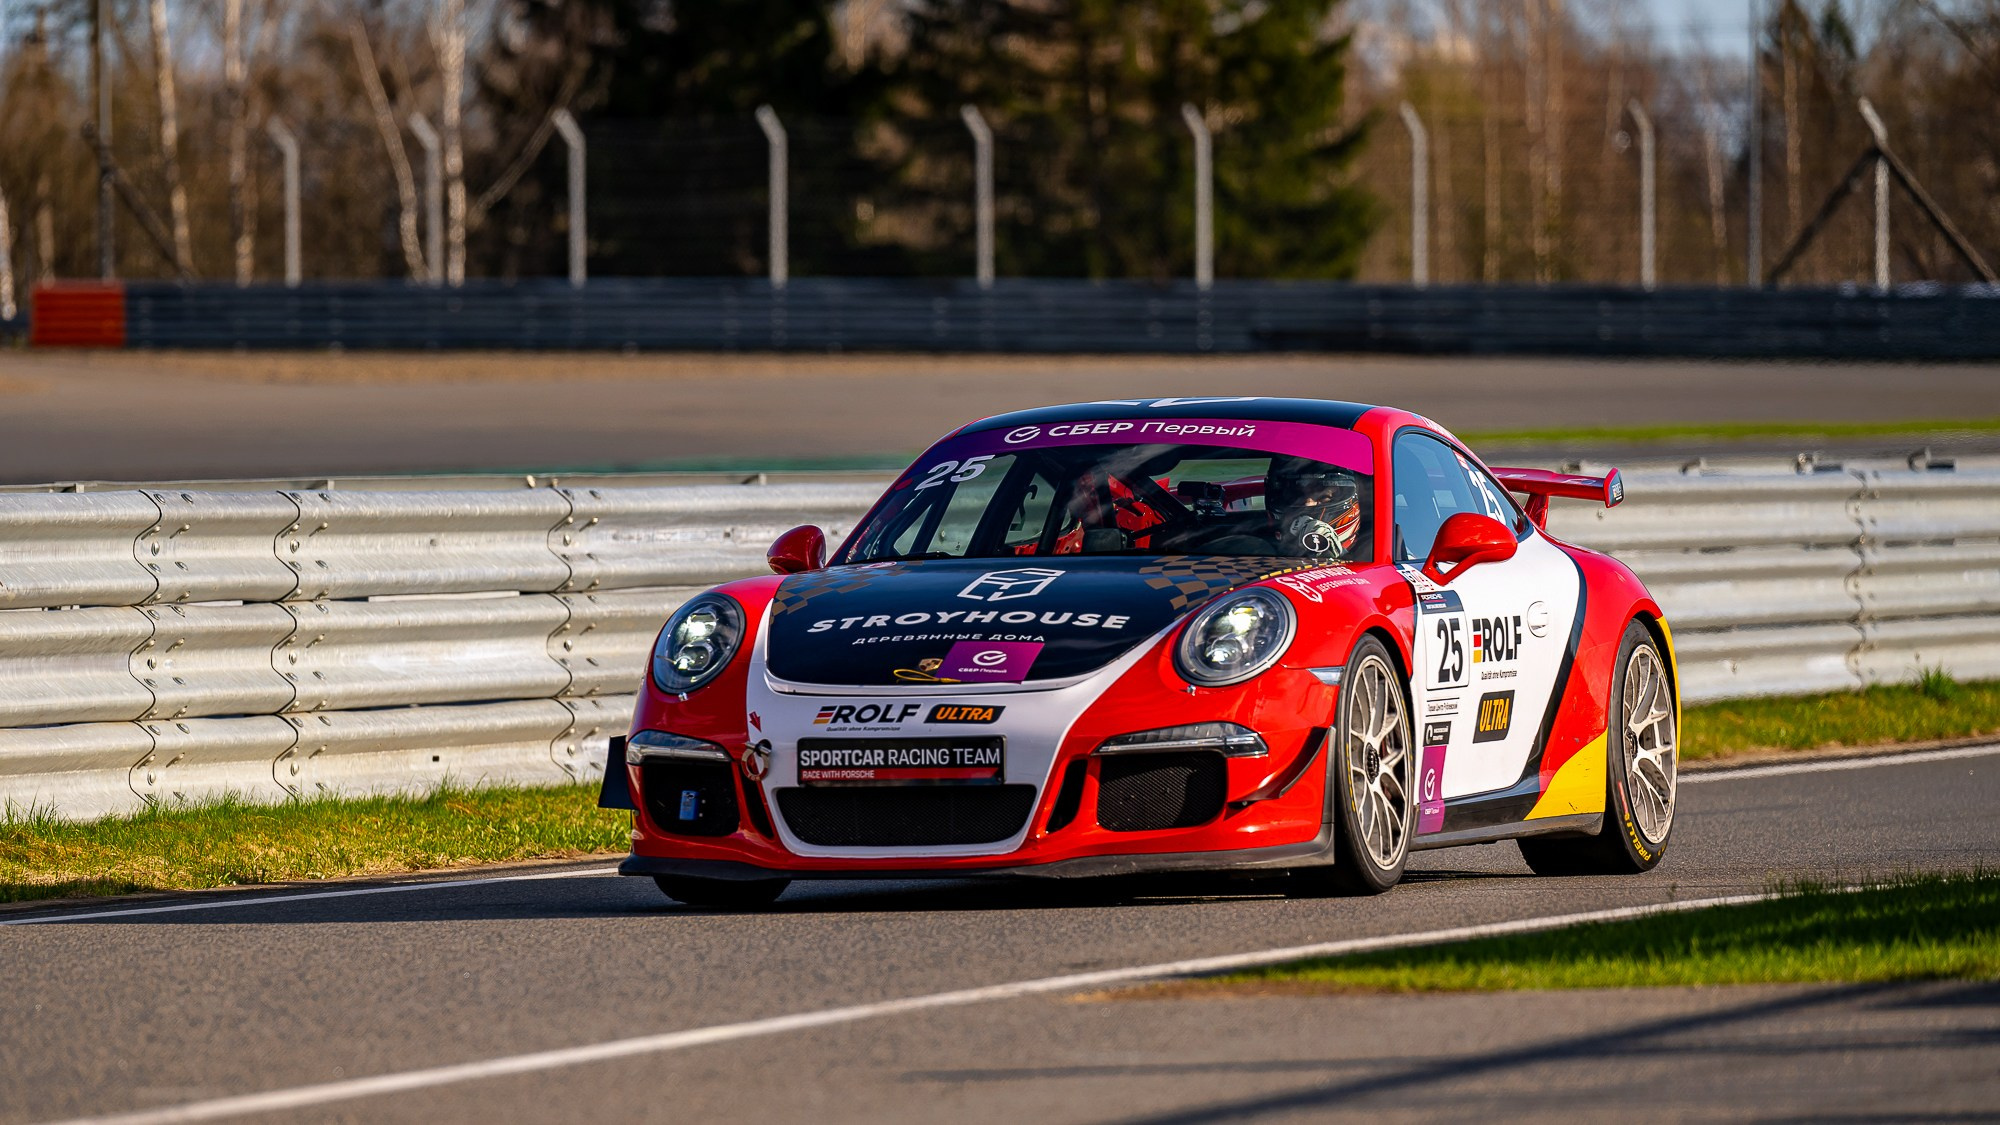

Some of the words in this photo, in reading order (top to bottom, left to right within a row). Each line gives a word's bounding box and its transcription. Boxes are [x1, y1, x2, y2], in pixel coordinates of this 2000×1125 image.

[1048, 422, 1134, 437] СБЕР
[1140, 422, 1256, 437] Первый
[914, 455, 996, 491] 25
[807, 611, 1130, 633] STROYHOUSE
[852, 633, 983, 645] ДЕРЕВЯННЫЕ
[988, 634, 1045, 642] ДОМА
[1481, 615, 1522, 663] ROLF
[1437, 618, 1464, 683] 25
[830, 703, 923, 724] ROLF
[935, 706, 995, 721] ULTRA
[1479, 698, 1510, 733] ULTRA
[800, 750, 885, 766] SPORTCAR
[888, 749, 950, 765] RACING
[953, 748, 1000, 765] TEAM
[802, 771, 820, 779] RACE
[821, 771, 841, 779] WITH
[841, 770, 875, 779] PORSCHE
[1626, 821, 1652, 861] PIRELLI
